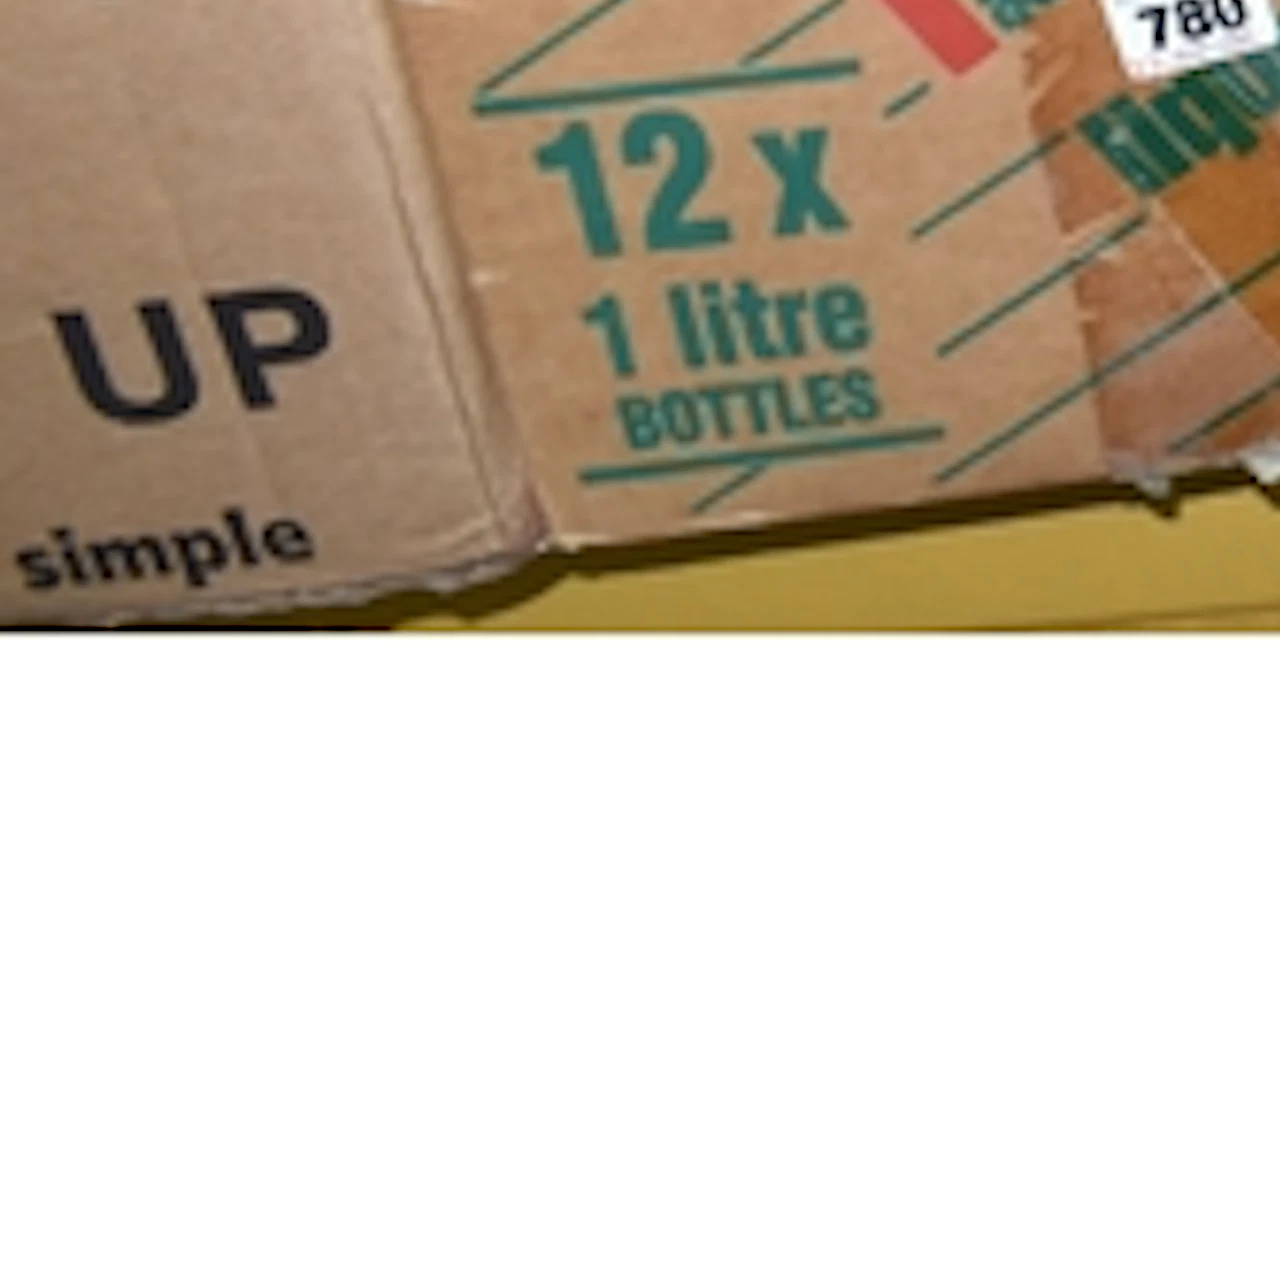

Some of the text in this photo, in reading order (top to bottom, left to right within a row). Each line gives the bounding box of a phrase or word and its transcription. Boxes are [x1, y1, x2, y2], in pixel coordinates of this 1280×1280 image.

[534, 109, 849, 259] 12 x
[49, 285, 332, 427] UP
[582, 278, 872, 378] 1 litre
[617, 369, 883, 452] BOTTLES
[16, 506, 316, 589] simple
